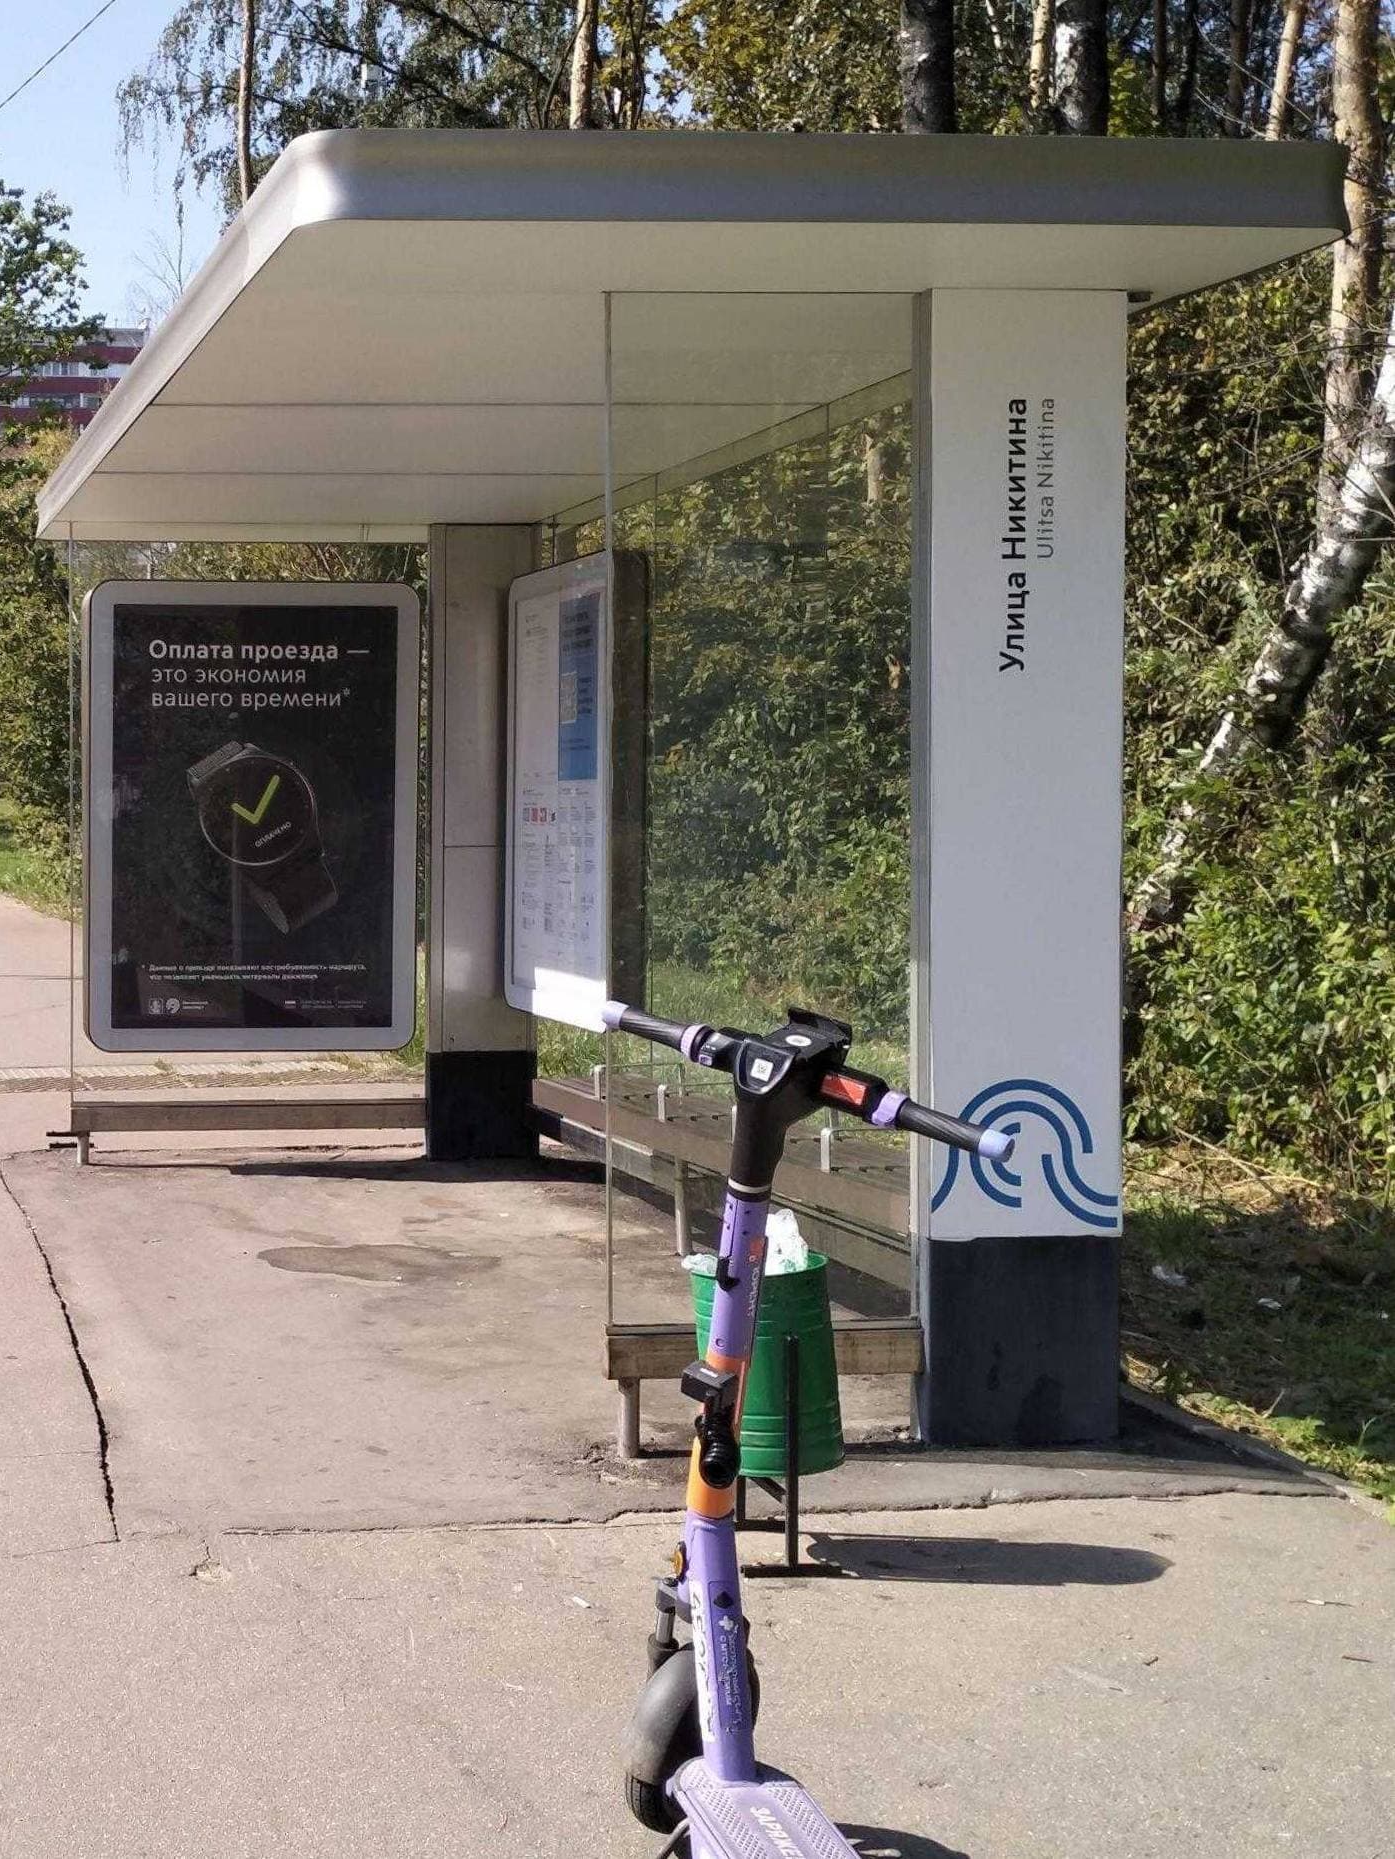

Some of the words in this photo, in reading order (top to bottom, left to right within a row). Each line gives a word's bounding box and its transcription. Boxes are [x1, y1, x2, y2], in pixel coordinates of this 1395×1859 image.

[1037, 398, 1055, 488] Nikitina
[1002, 398, 1027, 560] Никитина
[1037, 496, 1054, 559] Ulitsa
[149, 639, 234, 660] Оплата
[241, 643, 339, 663] проезда
[999, 572, 1030, 672] Улица
[151, 668, 188, 683] это
[195, 668, 307, 683] экономия
[151, 692, 233, 707] вашего
